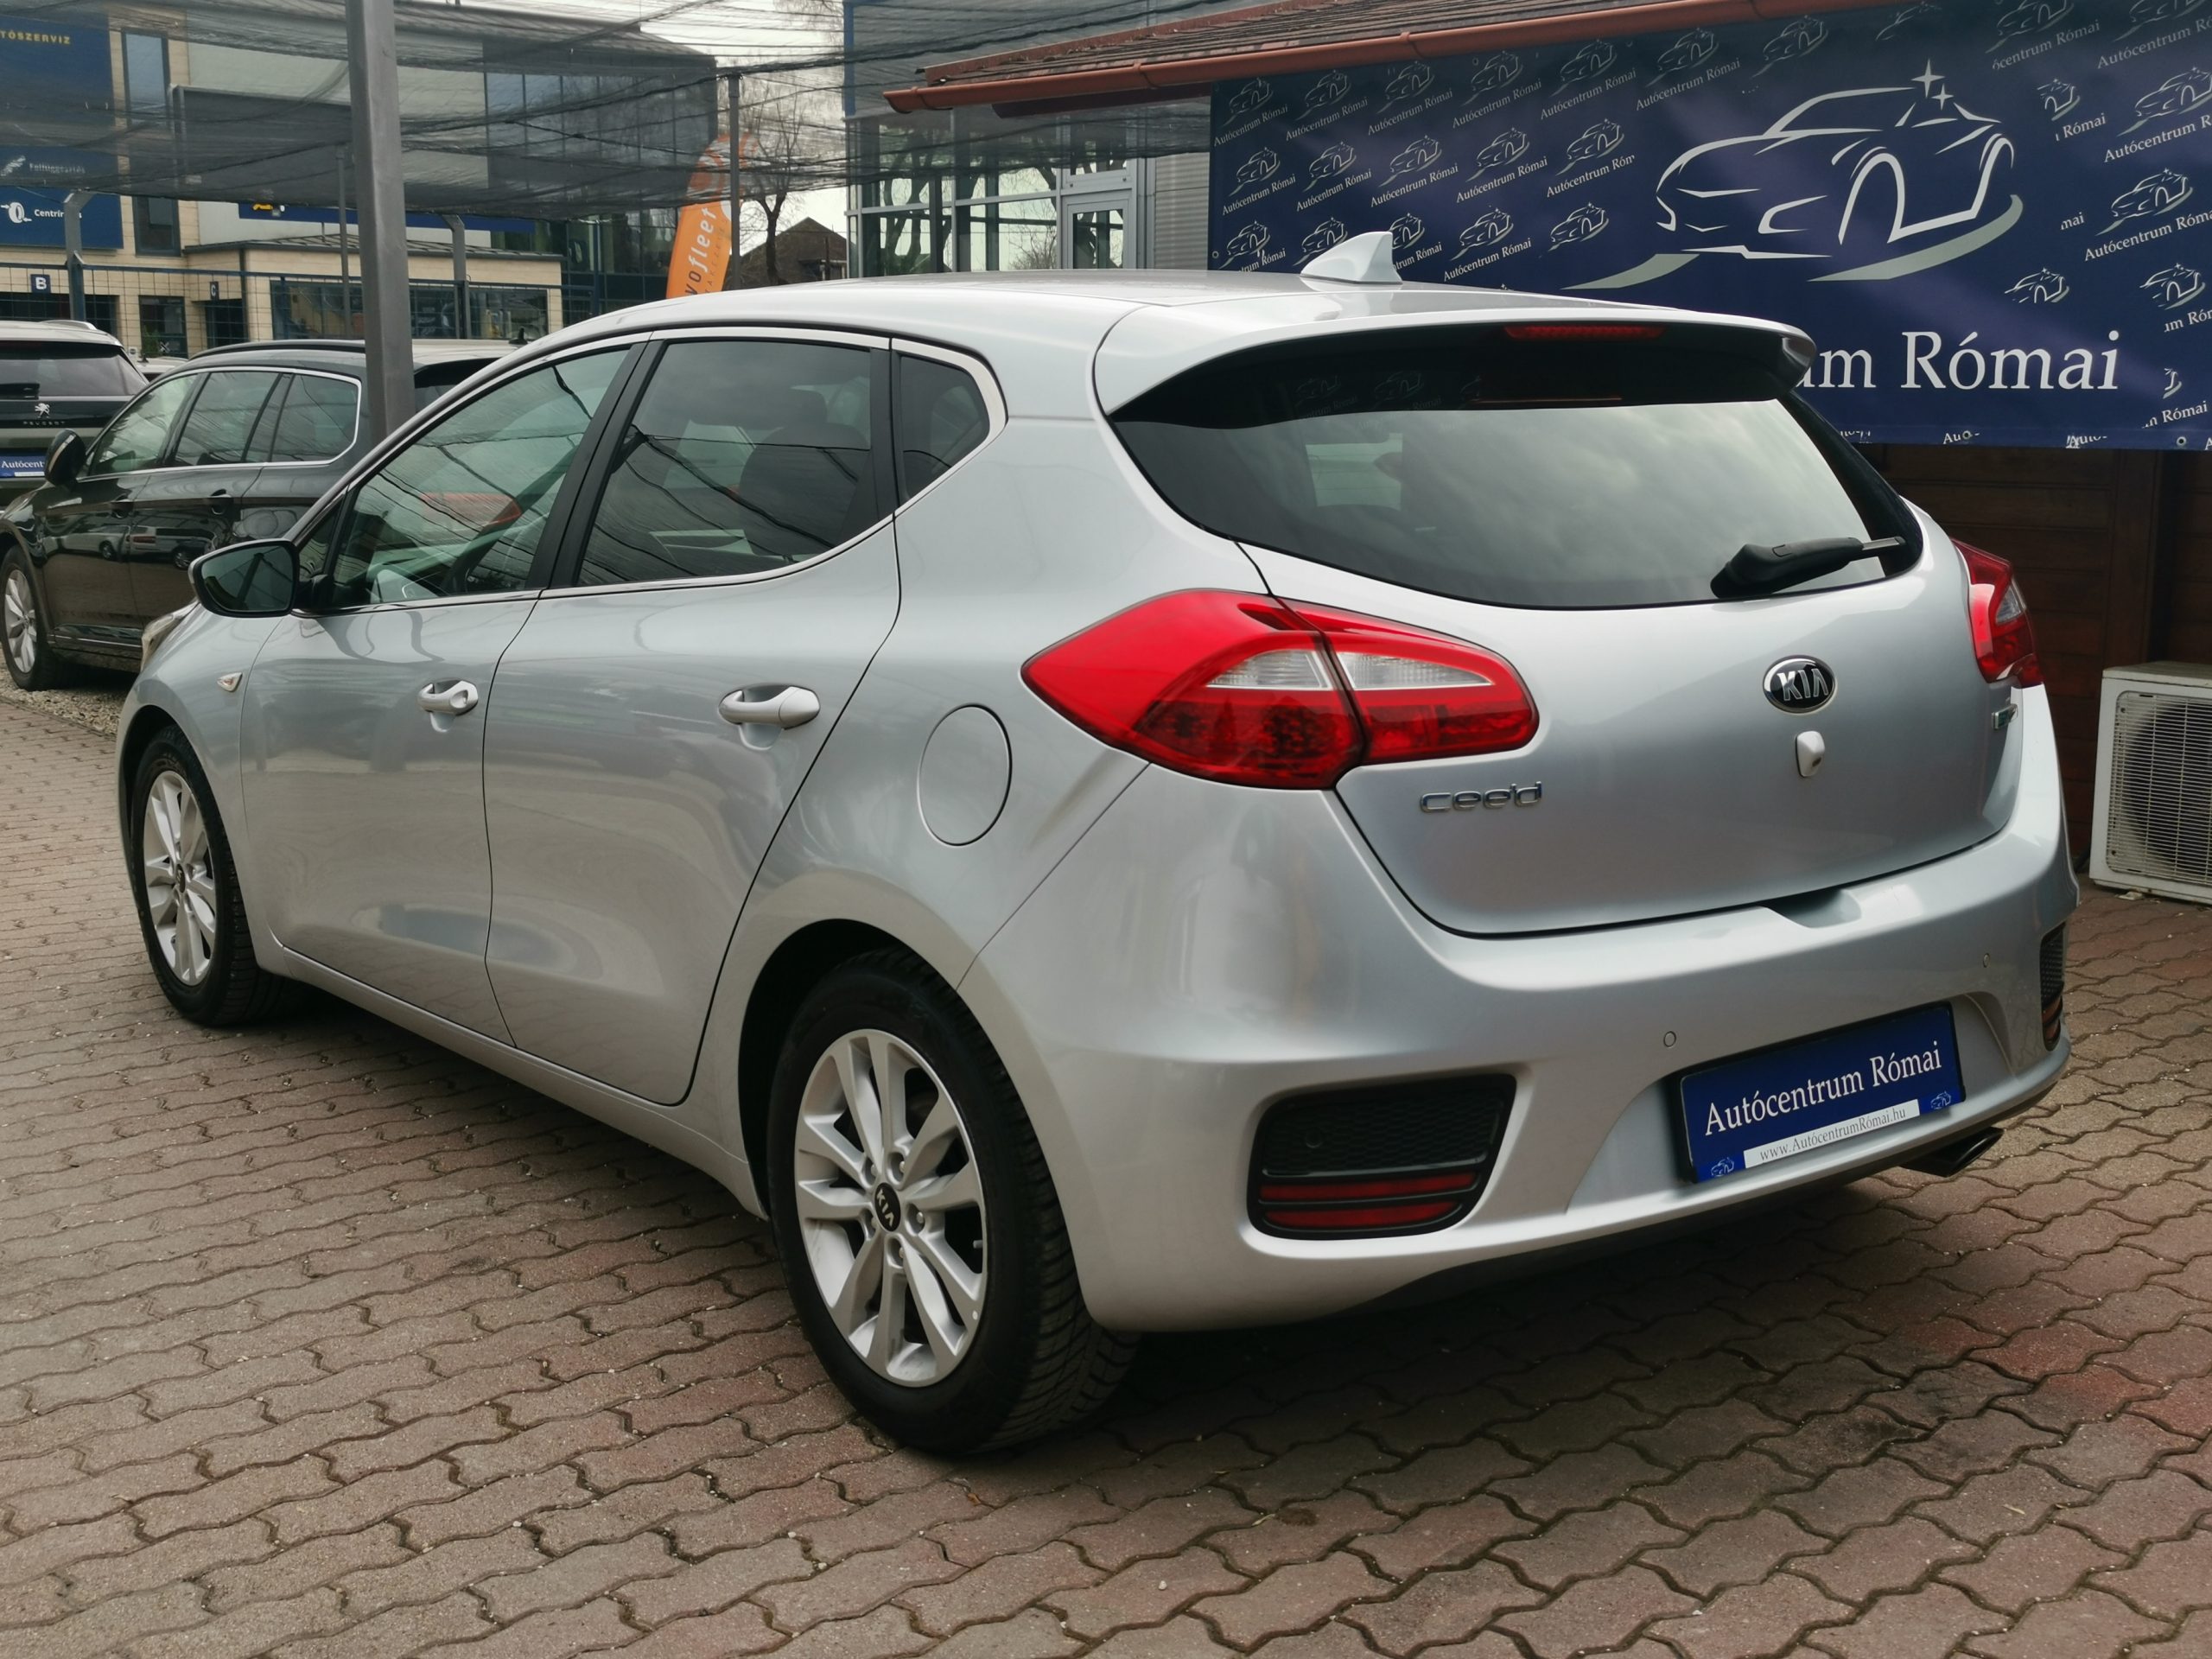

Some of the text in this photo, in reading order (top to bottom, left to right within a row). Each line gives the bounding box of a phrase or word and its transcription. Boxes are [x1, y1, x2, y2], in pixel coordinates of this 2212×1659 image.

[2056, 19, 2101, 45] Római
[2097, 28, 2191, 69] Autócentrum
[1452, 78, 1541, 129] Autócentrum Római
[1541, 67, 1637, 120] Autócentrum Római
[1636, 57, 1741, 111] Autócentrum Római
[1214, 104, 1288, 147] Autócentrum Római
[1286, 97, 1369, 141] Autócentrum Római
[1368, 88, 1453, 136] Autócentrum Római
[2063, 112, 2107, 139] Római
[2104, 121, 2196, 162] Autócentrum
[1223, 174, 1296, 215] Autócentrum Római
[1296, 168, 1372, 212] Autócentrum Római
[1370, 162, 1459, 207] Autócentrum Római
[1456, 156, 1548, 203] Autócentrum Római
[1547, 164, 1611, 198] Autócentrum
[1416, 241, 1442, 261] Római
[1444, 238, 1531, 282] Autócentrum Római
[2085, 224, 2172, 261] Autócentrum
[35, 276, 47, 290] B
[211, 284, 216, 296] C
[1901, 330, 2119, 390] Római
[2162, 400, 2208, 423] Római
[1777, 667, 1830, 701] KIA
[1705, 1040, 1942, 1136] Autócentrum Római
[1760, 1105, 1906, 1161] www.AutócentrumRómai.hu
[876, 1188, 895, 1227] KIA
